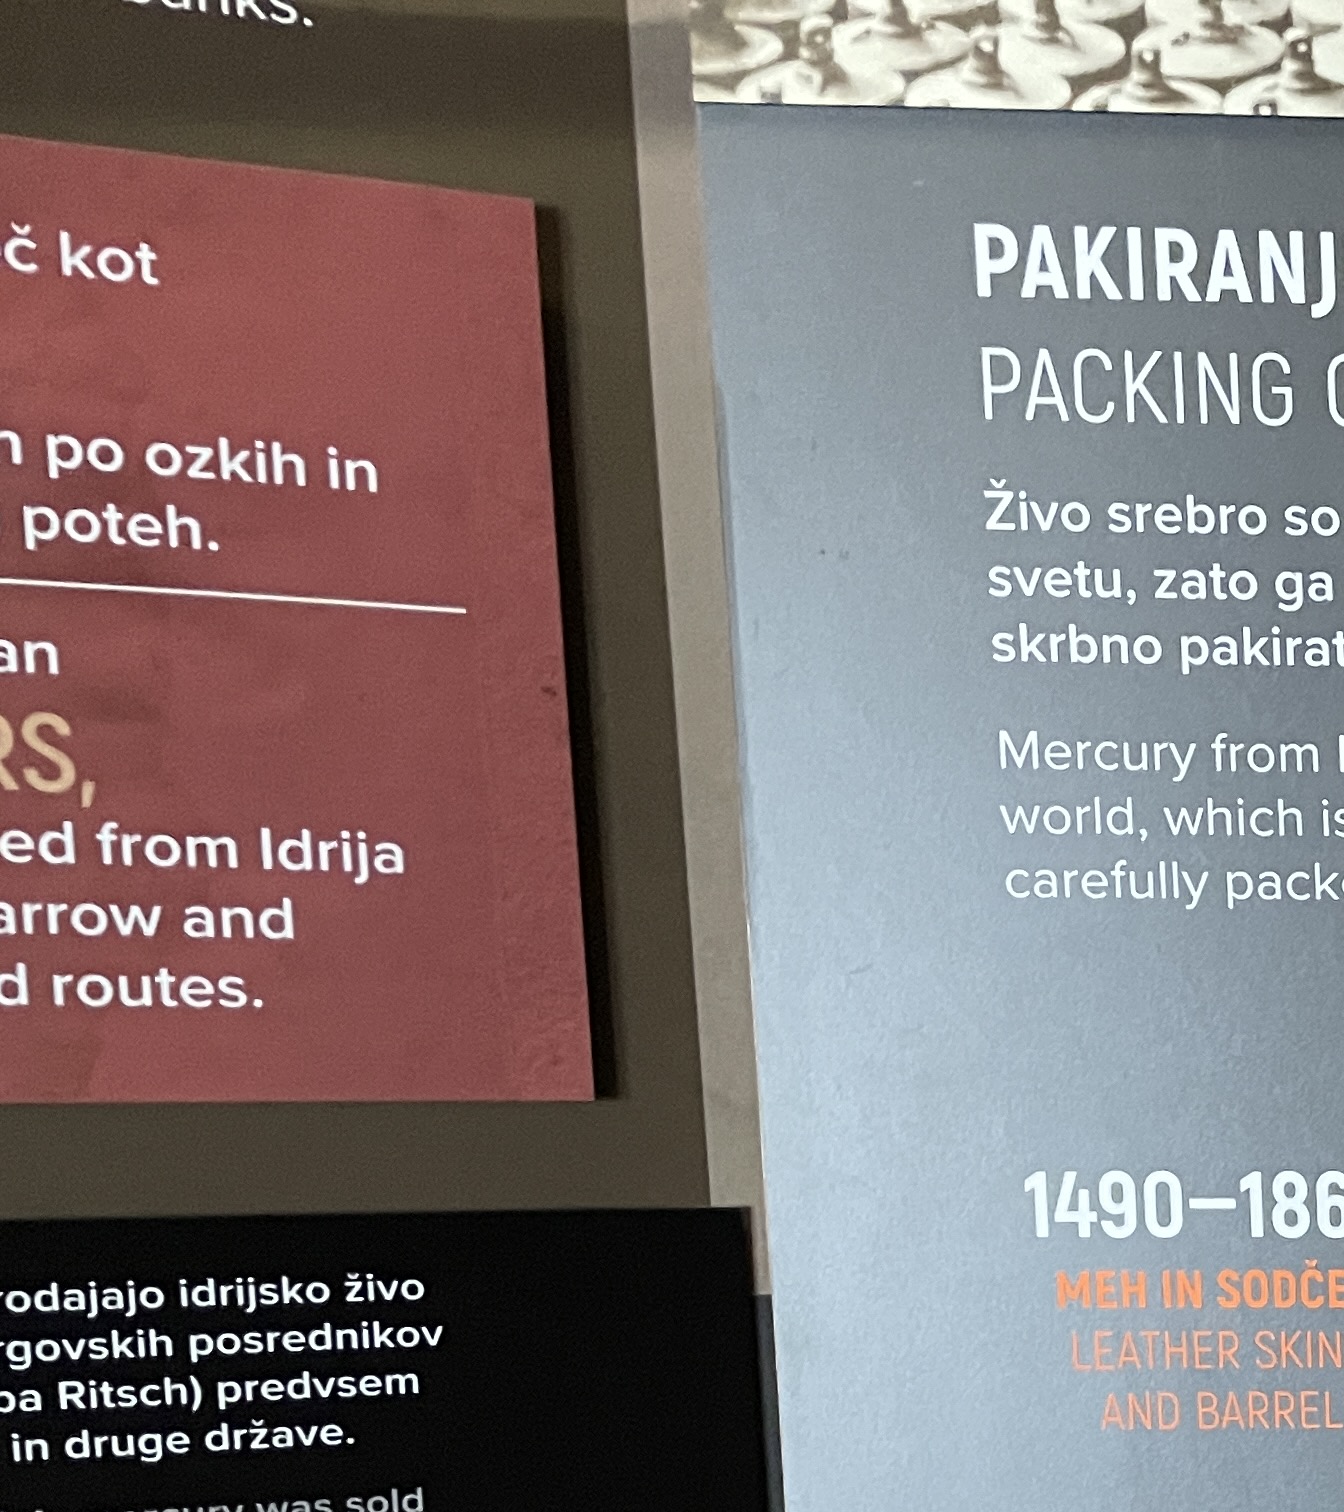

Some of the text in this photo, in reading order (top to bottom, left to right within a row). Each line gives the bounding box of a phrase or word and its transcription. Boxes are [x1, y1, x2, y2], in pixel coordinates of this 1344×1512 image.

[60, 231, 159, 285] kot
[982, 348, 1292, 426] PACKING
[47, 435, 124, 479] po
[146, 437, 305, 486] ozkih
[328, 447, 377, 492] in
[23, 504, 219, 551] poteh.
[984, 479, 1090, 531] Živo
[1108, 495, 1266, 535] srebro
[1285, 506, 1339, 536] so
[989, 561, 1135, 604] svetu,
[1154, 564, 1257, 600] zato
[1276, 572, 1333, 611] ga
[992, 623, 1162, 664] skrbno
[1000, 731, 1196, 781] Mercury
[1211, 733, 1318, 772] from
[96, 822, 404, 884] from Idrija
[184, 898, 294, 939] and
[53, 968, 263, 1008] routes.
[179, 1273, 424, 1313] idrijsko živo
[1057, 1270, 1147, 1309] MEH
[1162, 1270, 1203, 1308] IN
[190, 1321, 442, 1362] posrednikov
[1072, 1330, 1240, 1371] LEATHER
[58, 1371, 419, 1411] Ritsch) predvsem
[1102, 1389, 1343, 1431] AND BARREL
[11, 1420, 354, 1462] in druge države.
